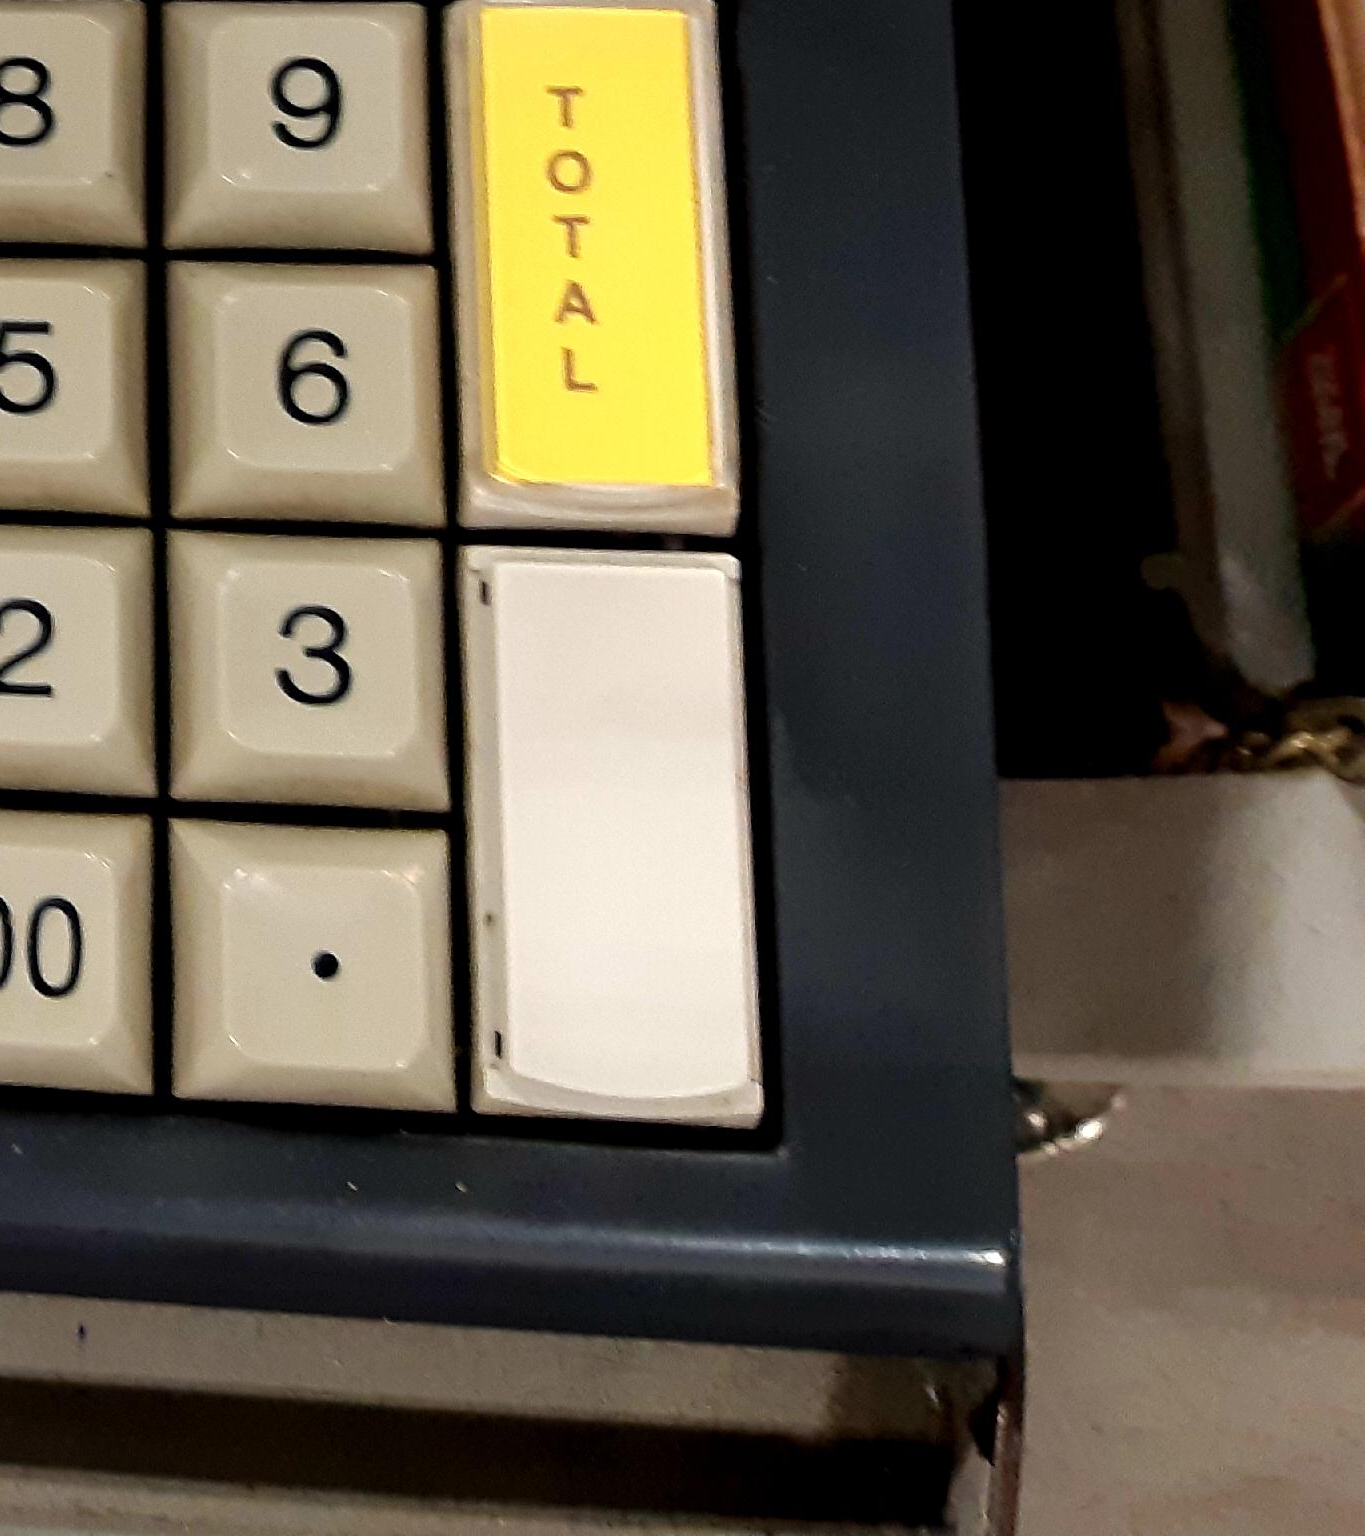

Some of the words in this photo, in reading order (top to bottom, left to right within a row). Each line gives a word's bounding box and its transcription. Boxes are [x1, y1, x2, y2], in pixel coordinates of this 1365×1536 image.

[271, 57, 343, 149] 9
[278, 330, 350, 425] 6
[276, 606, 352, 706] 3
